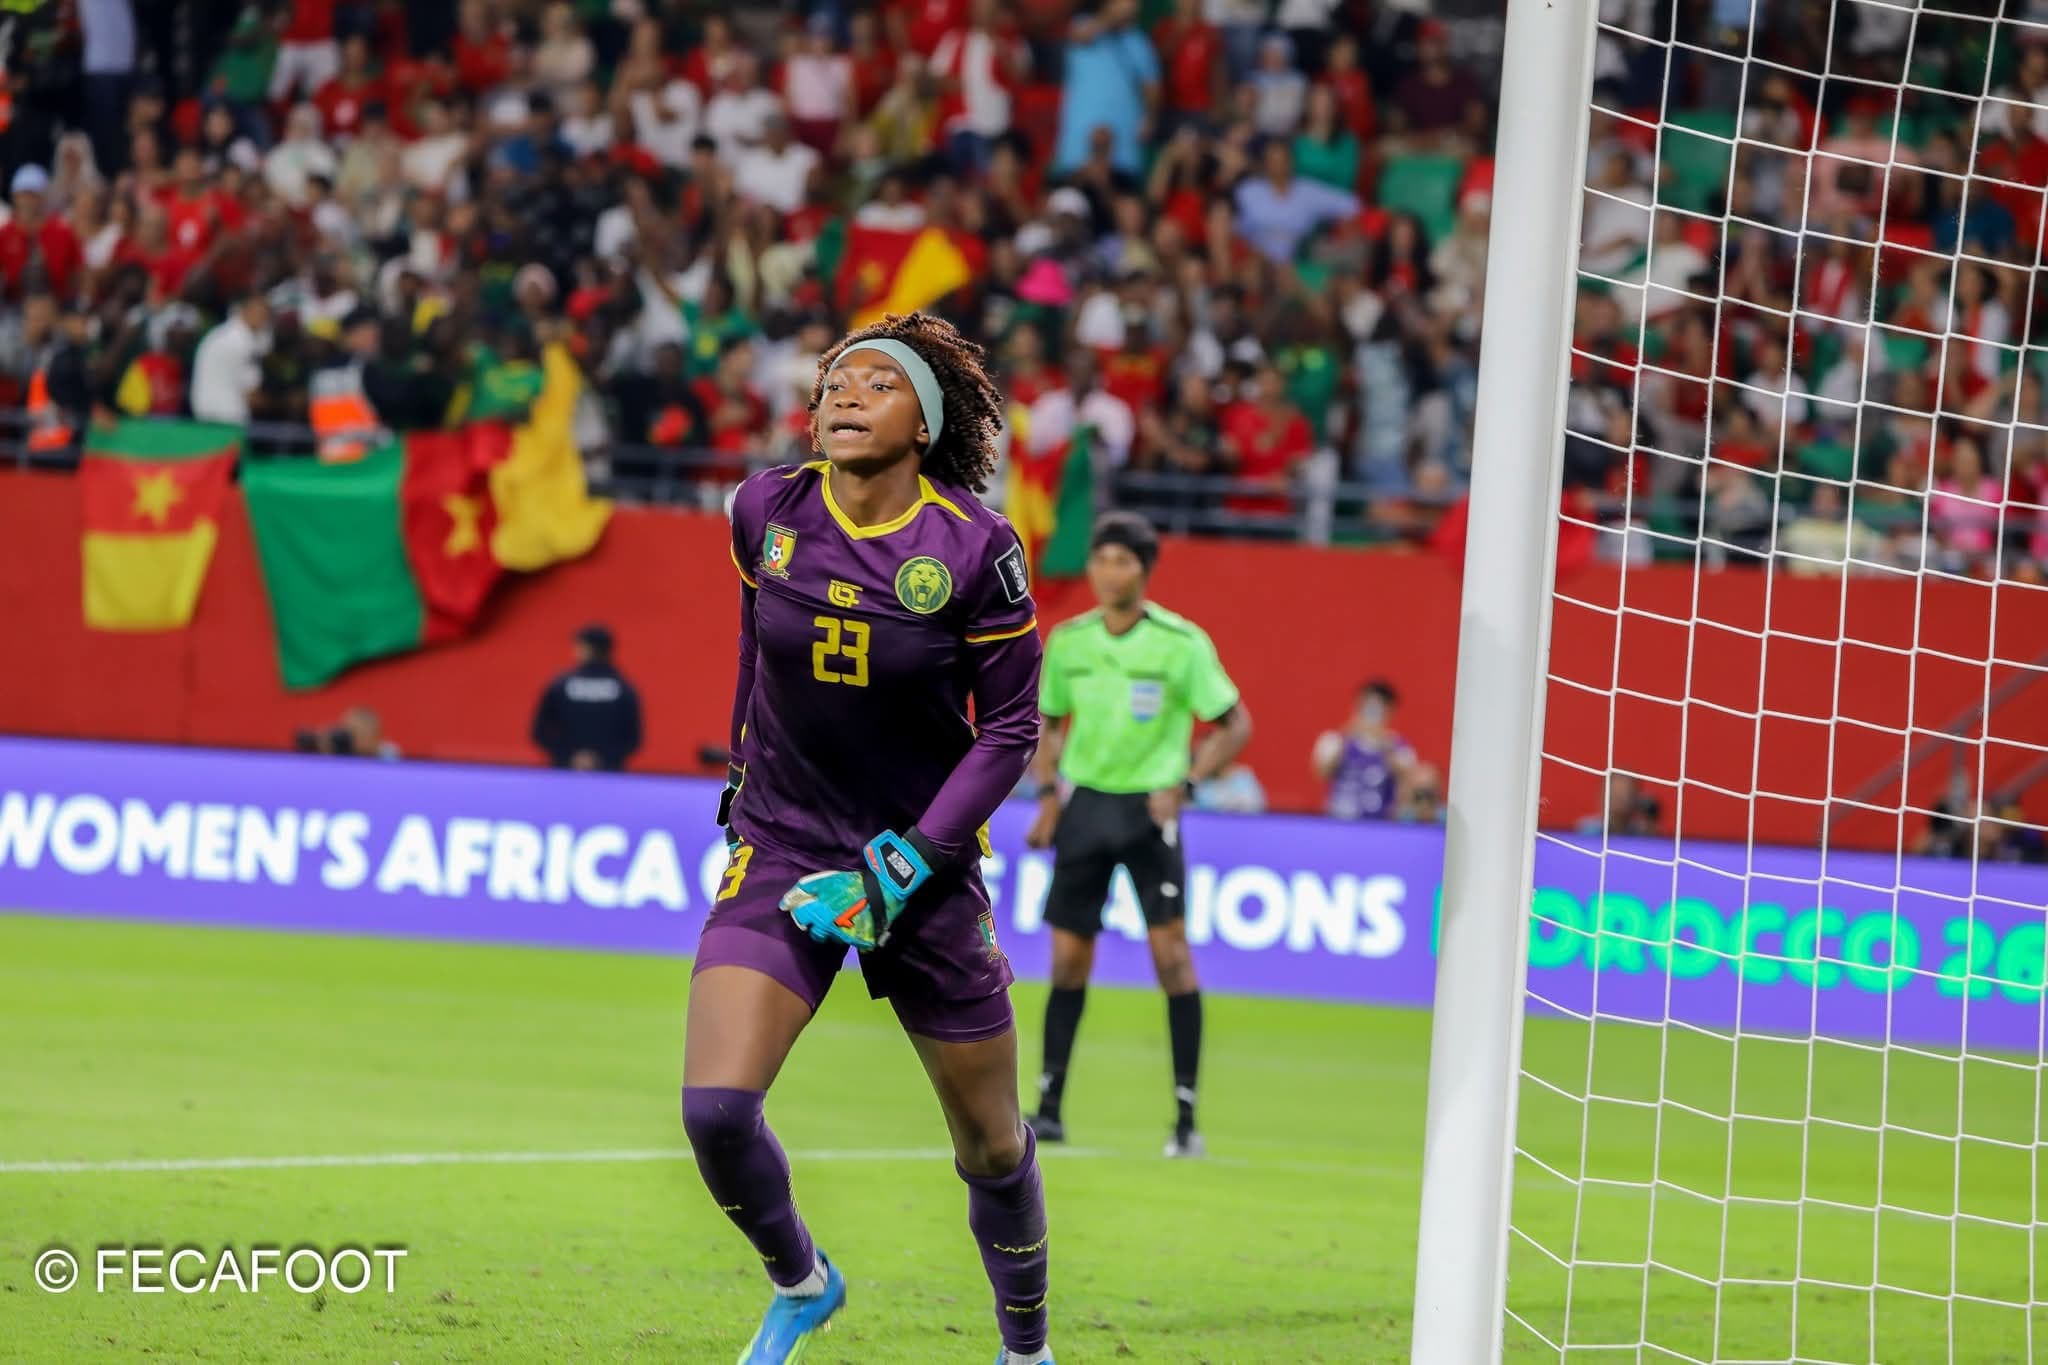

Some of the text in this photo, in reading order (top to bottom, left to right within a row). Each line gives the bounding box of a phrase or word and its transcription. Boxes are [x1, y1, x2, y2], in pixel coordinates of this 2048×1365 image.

[812, 615, 871, 687] 23
[0, 790, 371, 889] WOMEN'S
[377, 815, 689, 911] AFRICA
[1430, 880, 2048, 1006] OROCCO 26
